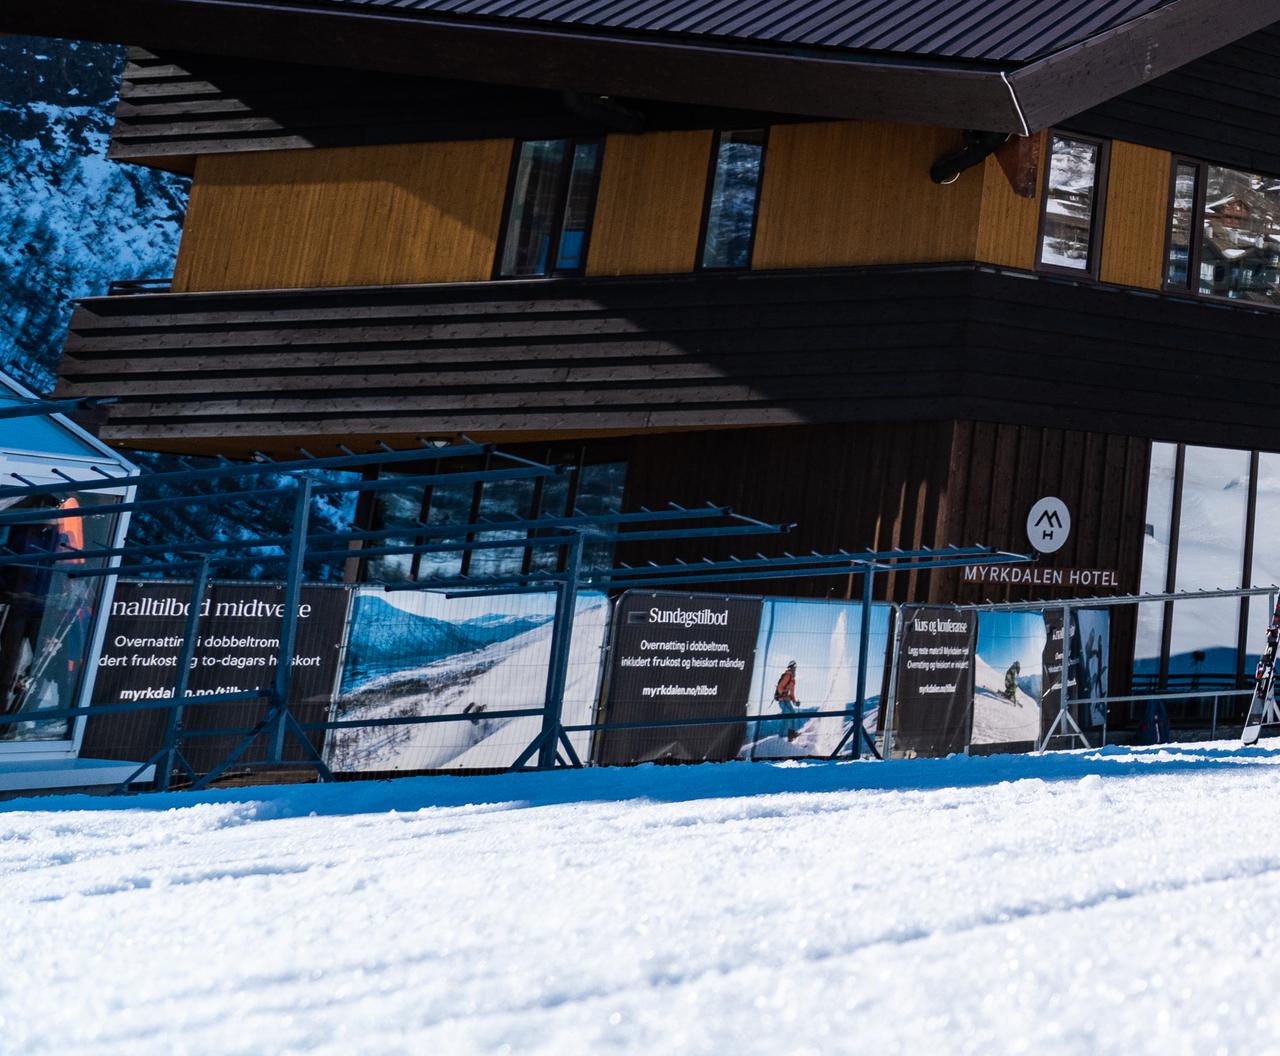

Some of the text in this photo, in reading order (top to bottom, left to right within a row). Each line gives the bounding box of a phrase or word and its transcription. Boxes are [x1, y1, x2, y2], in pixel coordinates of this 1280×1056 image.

[964, 566, 1119, 586] MYRKDALEN HOTEL
[111, 597, 312, 618] nalltilbod midtvee
[648, 607, 729, 628] Sundagstilbod
[914, 618, 968, 635] Kurs og konferanse
[114, 635, 184, 648] Overnattin
[196, 636, 202, 647] i
[640, 639, 685, 653] Overnatting
[690, 640, 730, 653] dobbeltrom,
[131, 654, 177, 666] frukost
[202, 654, 266, 668] to-dagars
[268, 654, 321, 666] hskort
[620, 656, 745, 670] inkludert frukost og heiskort måndag
[642, 685, 718, 697] myrkdalen.no/tilbod
